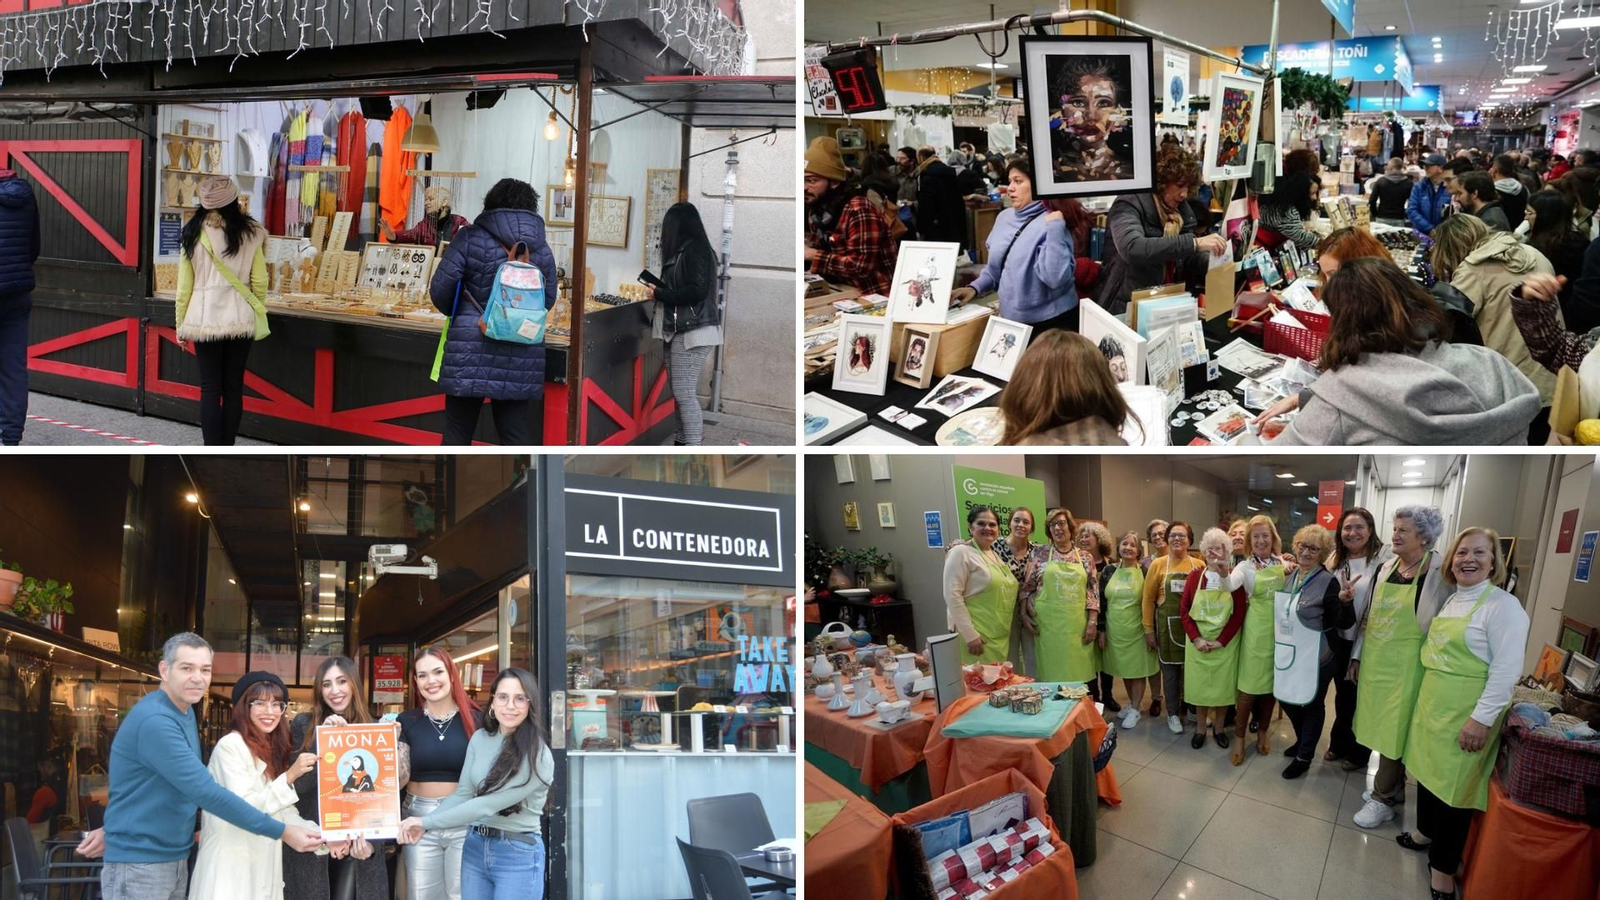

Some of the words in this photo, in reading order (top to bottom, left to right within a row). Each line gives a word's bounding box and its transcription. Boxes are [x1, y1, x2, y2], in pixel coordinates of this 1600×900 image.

[1338, 43, 1368, 59] TOÑI
[584, 523, 609, 545] LA
[632, 528, 771, 558] CONTENEDORA
[737, 635, 789, 662] TAKE
[376, 680, 401, 688] 35.928
[733, 663, 796, 693] AWAY
[328, 733, 388, 747] MONA
